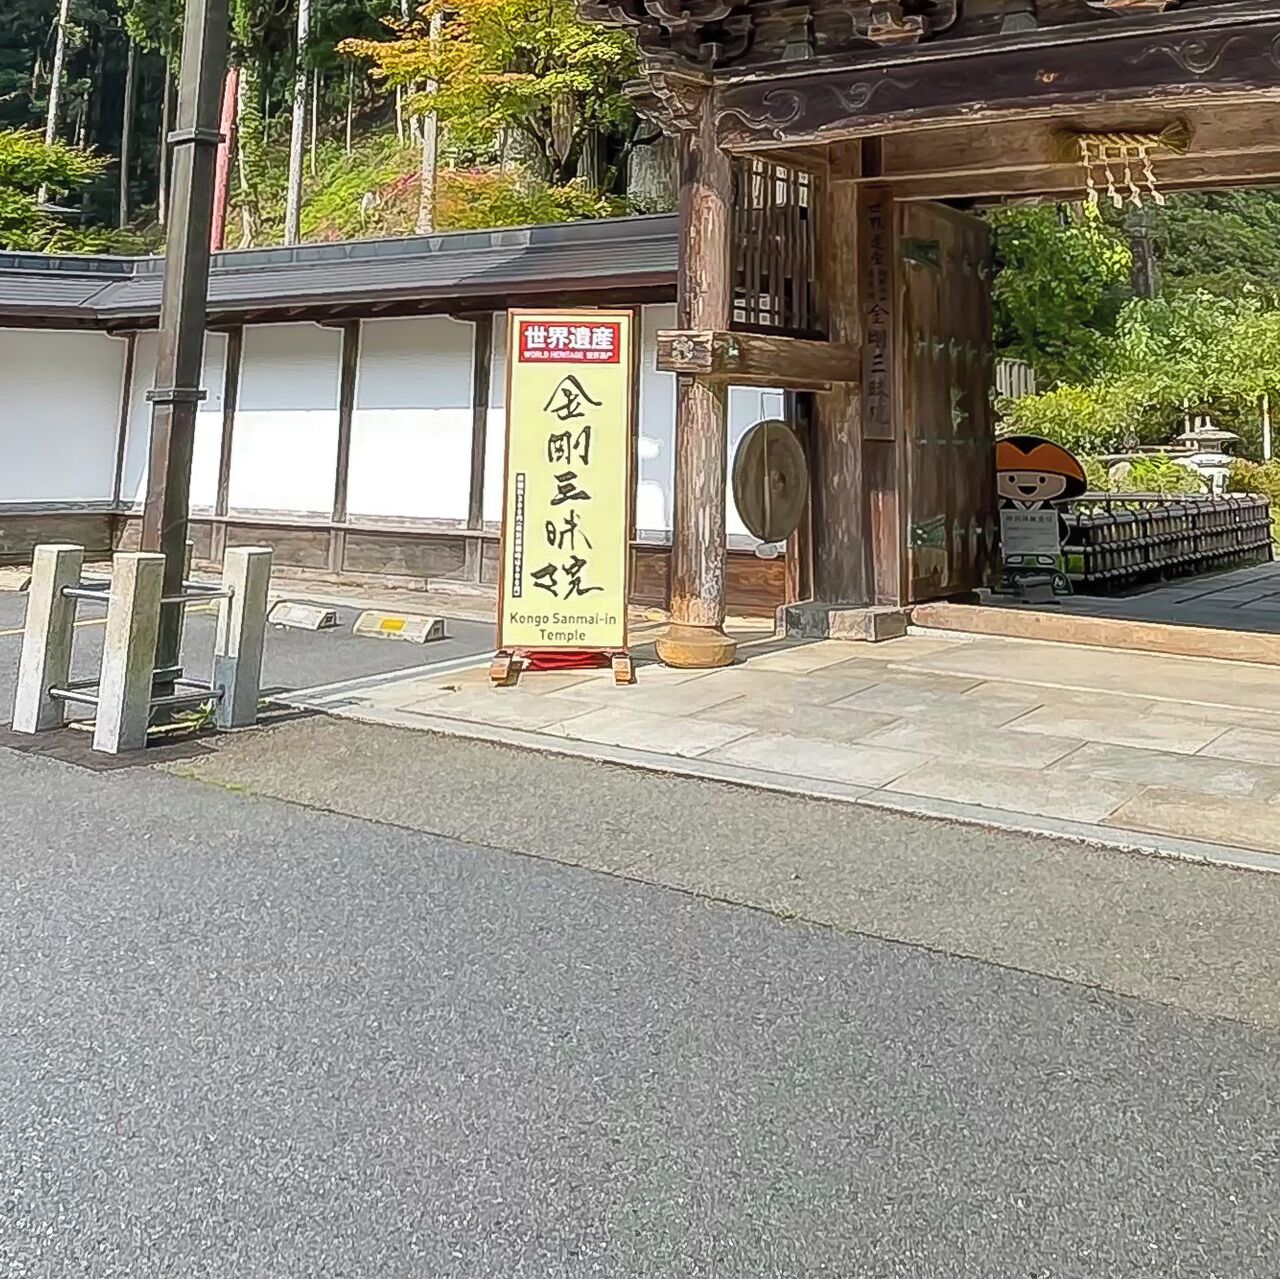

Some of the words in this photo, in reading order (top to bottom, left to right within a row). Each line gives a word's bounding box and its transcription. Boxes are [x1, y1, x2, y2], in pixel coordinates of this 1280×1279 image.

[524, 325, 614, 349] 世界遺産
[530, 374, 604, 600] 金剛三昧院
[510, 612, 549, 627] Kongo
[552, 612, 616, 624] Sanmai-in
[539, 629, 586, 642] Temple
